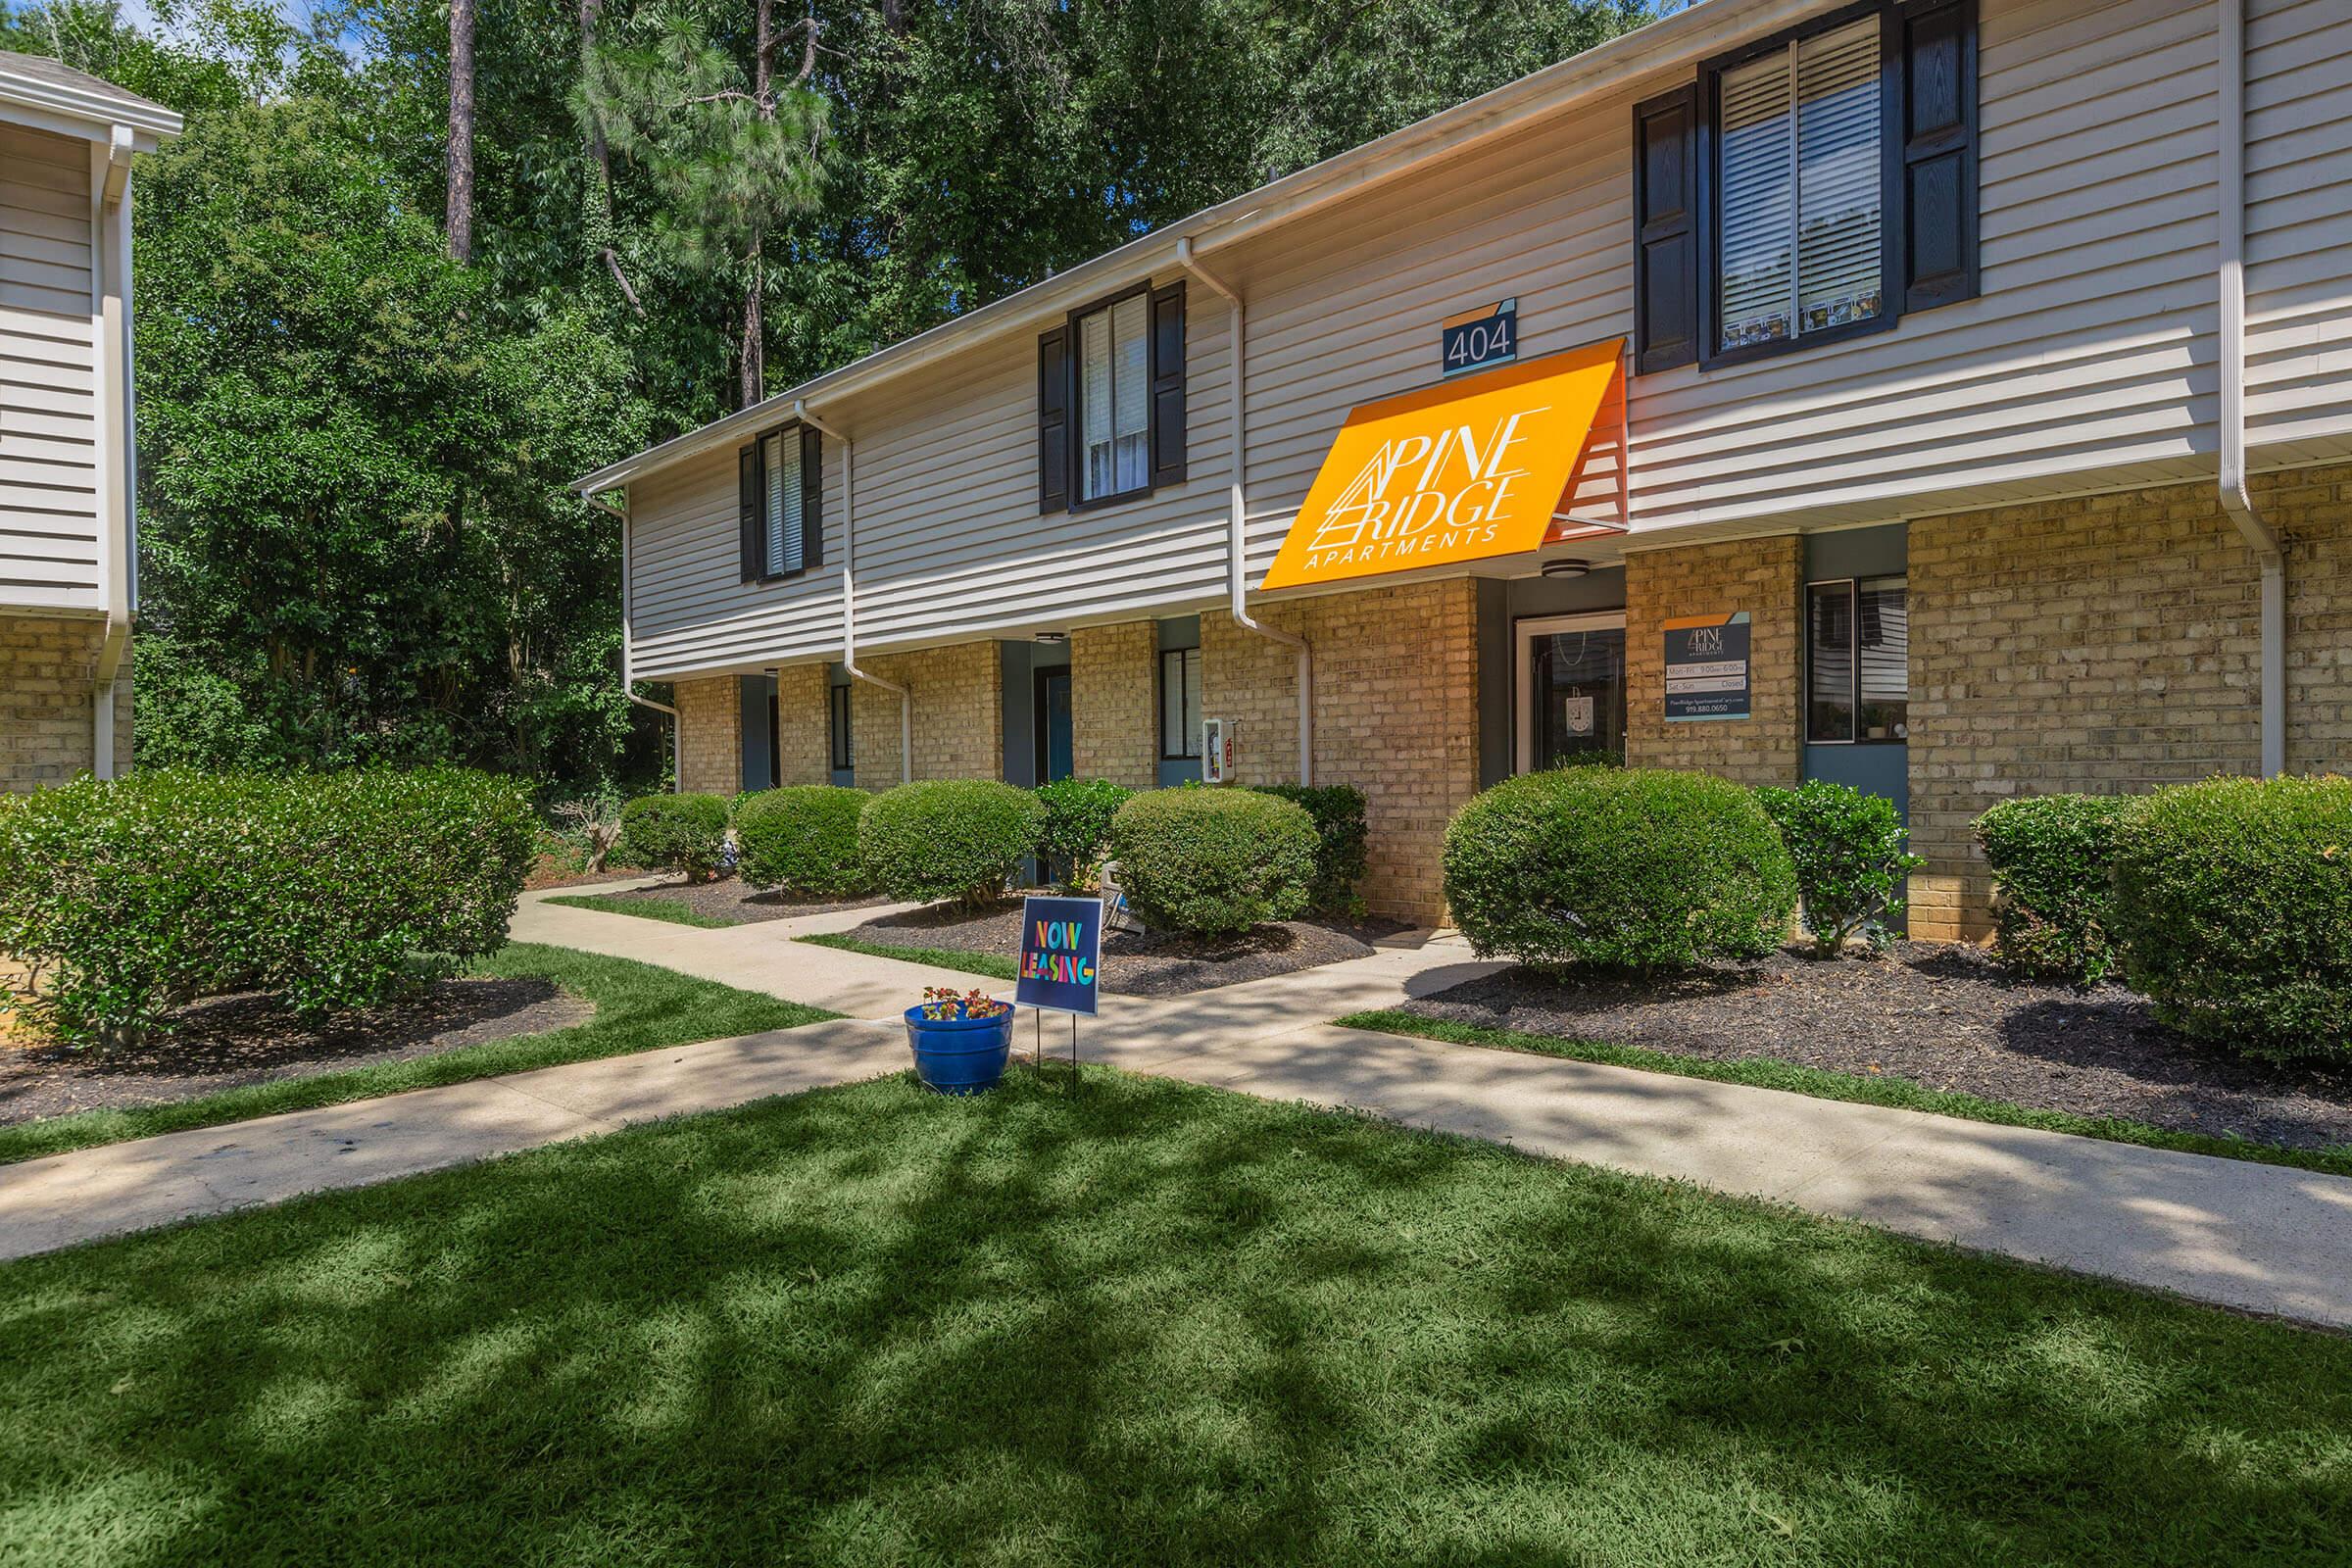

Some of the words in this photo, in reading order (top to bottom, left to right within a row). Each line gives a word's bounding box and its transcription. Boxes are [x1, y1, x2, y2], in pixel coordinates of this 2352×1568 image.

[1448, 319, 1510, 365] 404
[1371, 406, 1552, 500] PINE
[1353, 471, 1531, 544] RIDGE
[1303, 523, 1498, 570] APARTMENTS
[1695, 627, 1724, 643] PINE
[1695, 640, 1724, 652] RIDGE
[1685, 704, 1728, 713] 919.880.0650
[1035, 920, 1082, 951] NOW
[1020, 951, 1095, 985] LEASING
